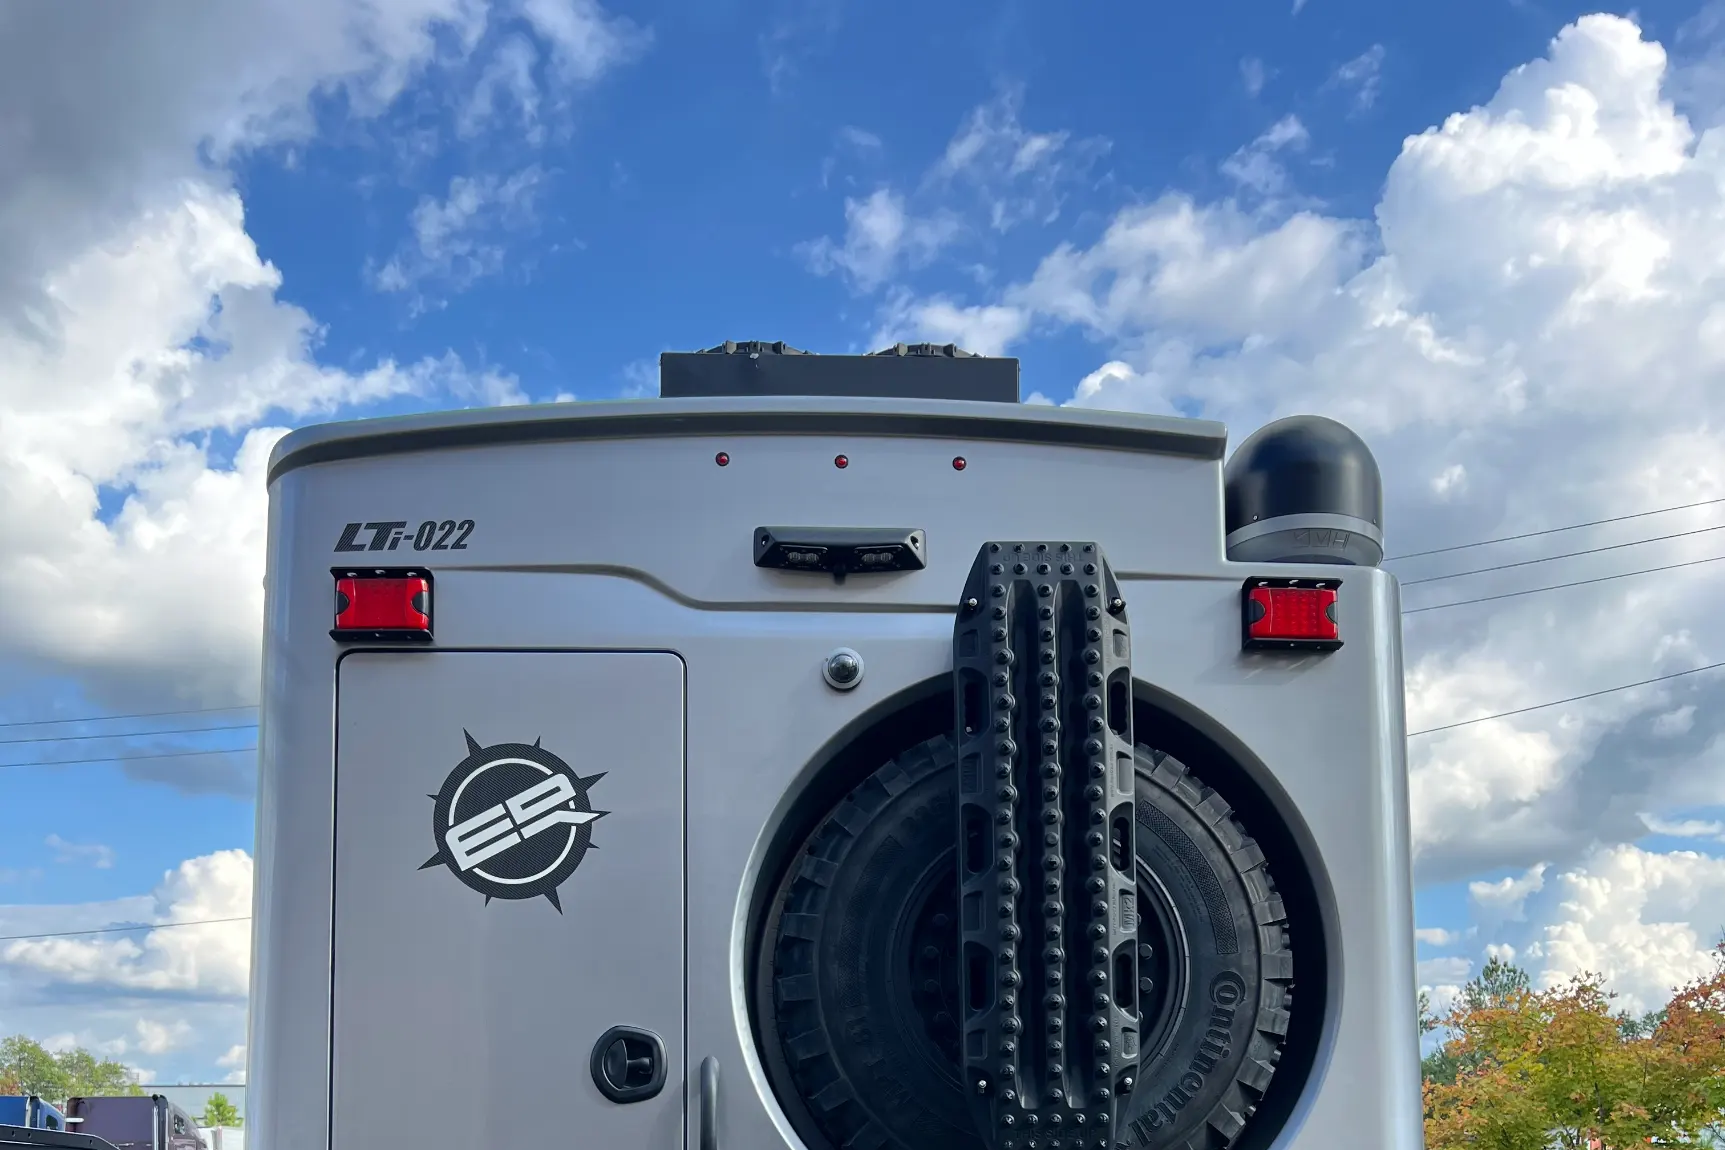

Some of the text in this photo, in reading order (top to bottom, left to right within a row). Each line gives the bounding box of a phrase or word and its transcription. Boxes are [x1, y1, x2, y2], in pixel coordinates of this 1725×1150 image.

[333, 519, 476, 553] LTi-022
[1022, 551, 1053, 563] SIDE
[1127, 968, 1248, 1149] Continental
[1044, 1128, 1074, 1140] SIDE
